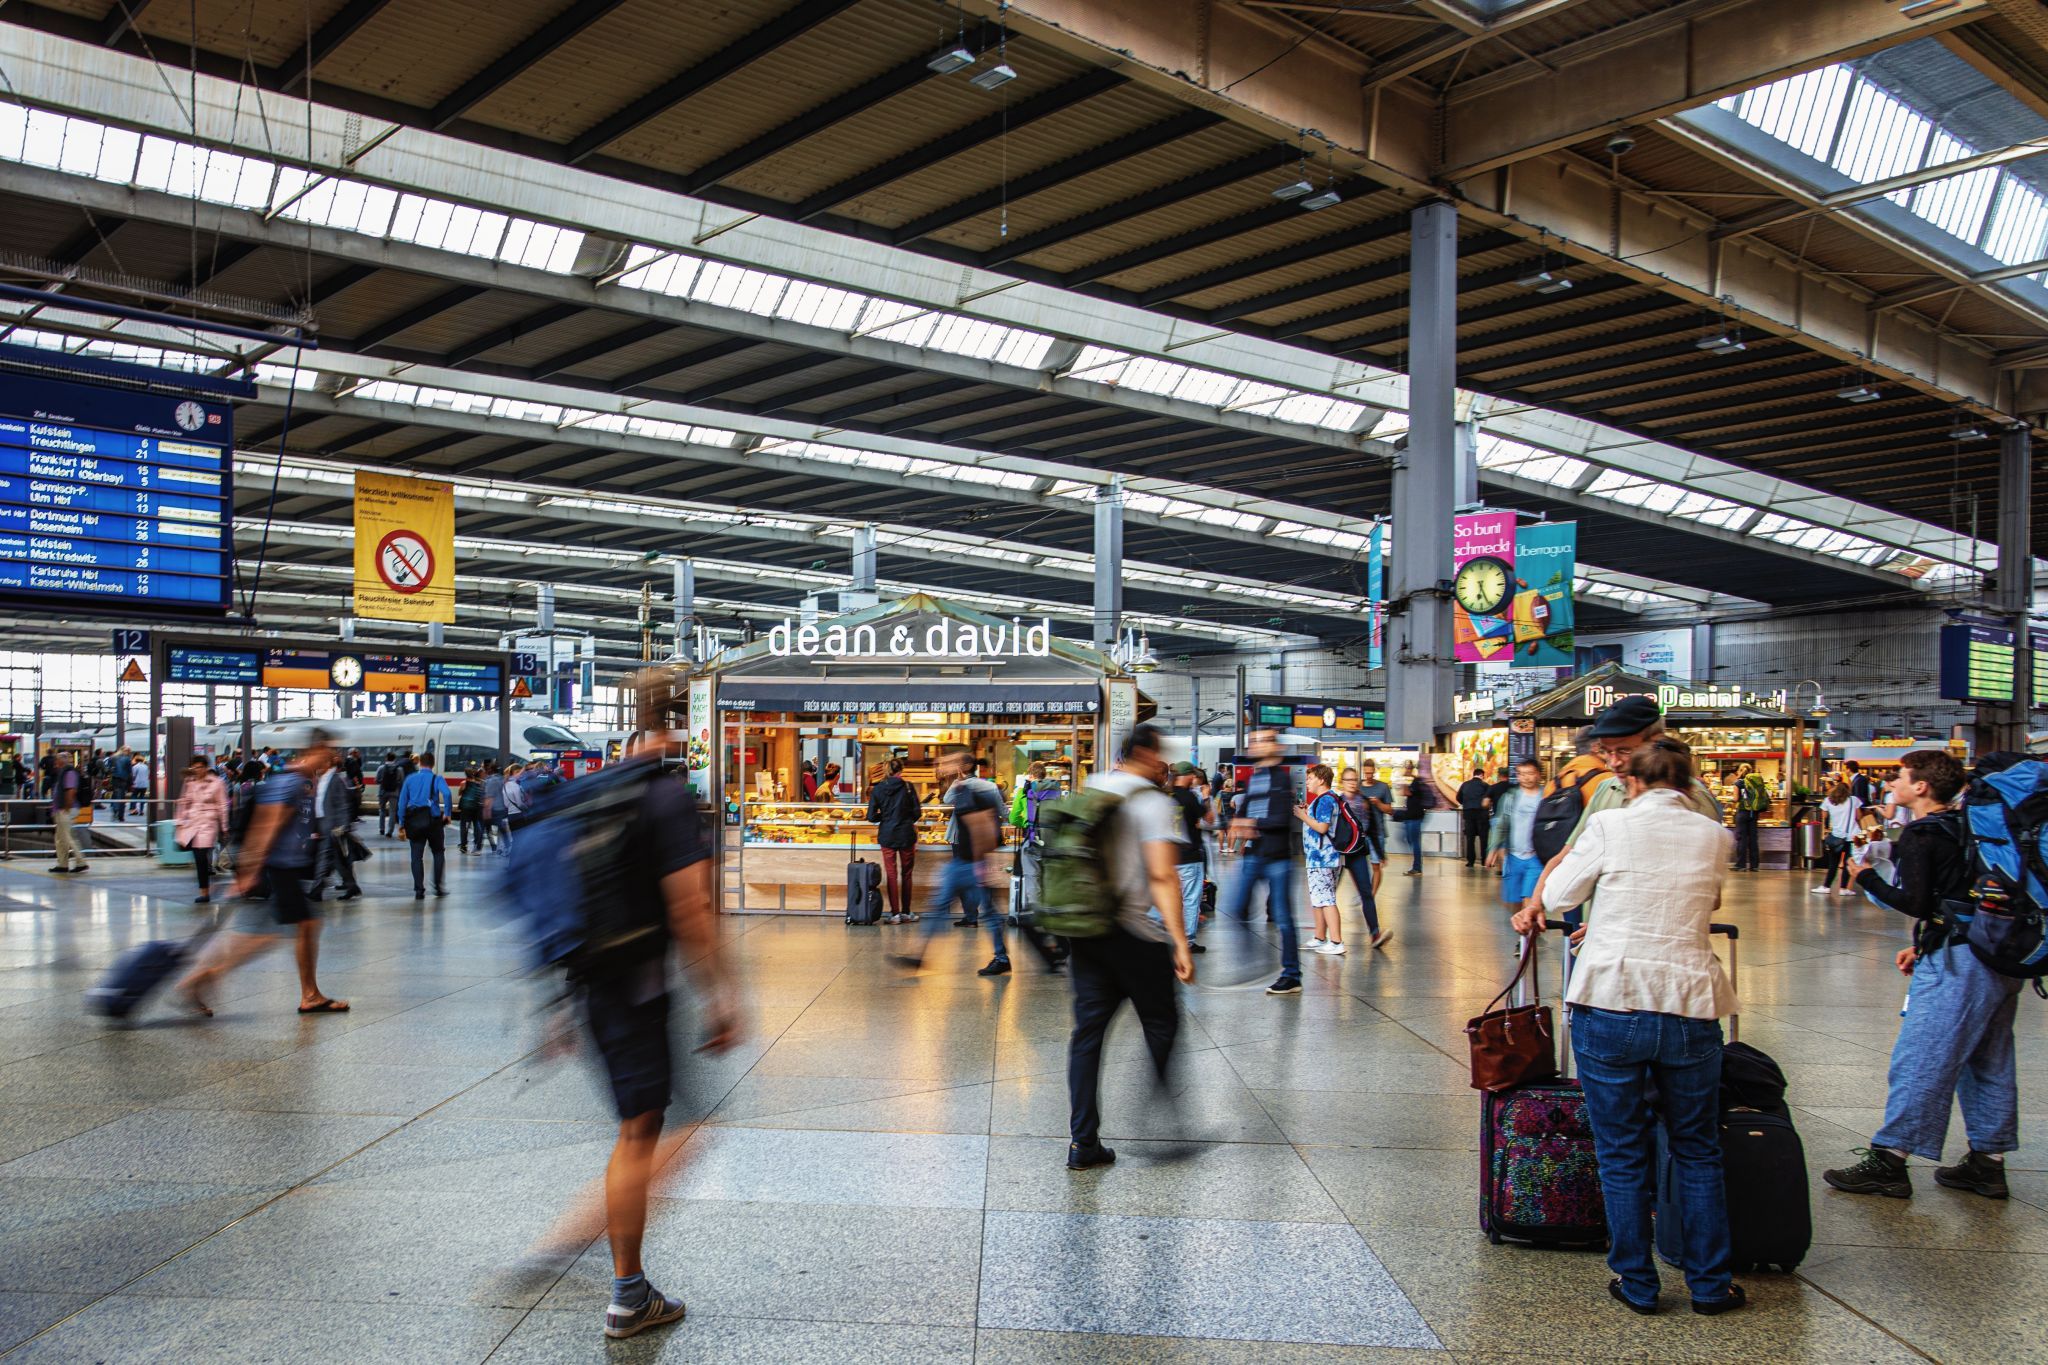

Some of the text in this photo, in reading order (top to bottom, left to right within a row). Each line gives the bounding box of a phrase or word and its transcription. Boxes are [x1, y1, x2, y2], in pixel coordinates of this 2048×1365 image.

[30, 424, 72, 438] Kufstein
[30, 436, 96, 453] Treuchtlingen
[141, 439, 149, 448] 6
[30, 452, 98, 469] Frankfurt Hbf
[136, 449, 148, 459] 21
[78, 469, 124, 485] (Oberbay)
[137, 465, 149, 476] 15
[141, 477, 149, 486] 5
[136, 492, 148, 502] 31
[359, 486, 390, 497] Herzlich
[30, 492, 71, 505] Ulm Hbf
[137, 503, 149, 514] 13
[30, 509, 99, 525] Dortmund Hbf
[30, 521, 83, 534] Rosenheim
[136, 520, 149, 530] 22
[1454, 521, 1502, 537] So bunt
[30, 537, 72, 550] Kufstein
[1454, 539, 1511, 556] schmeckt
[30, 549, 97, 564] Marktredwitz
[141, 548, 149, 558] 9
[30, 565, 99, 580] Karlsruhe Hbf
[137, 574, 149, 584] 12
[137, 584, 149, 595] 19
[118, 630, 142, 650] 12
[769, 617, 876, 656] dean
[890, 624, 915, 656] &
[926, 616, 1050, 657] david
[517, 653, 534, 671] 13
[804, 701, 820, 712] FRESH
[821, 701, 840, 712] SALADS
[843, 701, 859, 712] FRESH
[879, 701, 894, 712] FRESH
[895, 701, 928, 712] SANDWICHES
[930, 701, 946, 712] FRESH
[969, 701, 984, 712] FRESH
[1006, 701, 1022, 712] FRESH
[1047, 701, 1063, 712] FRESH
[1064, 701, 1083, 712] COFFEE
